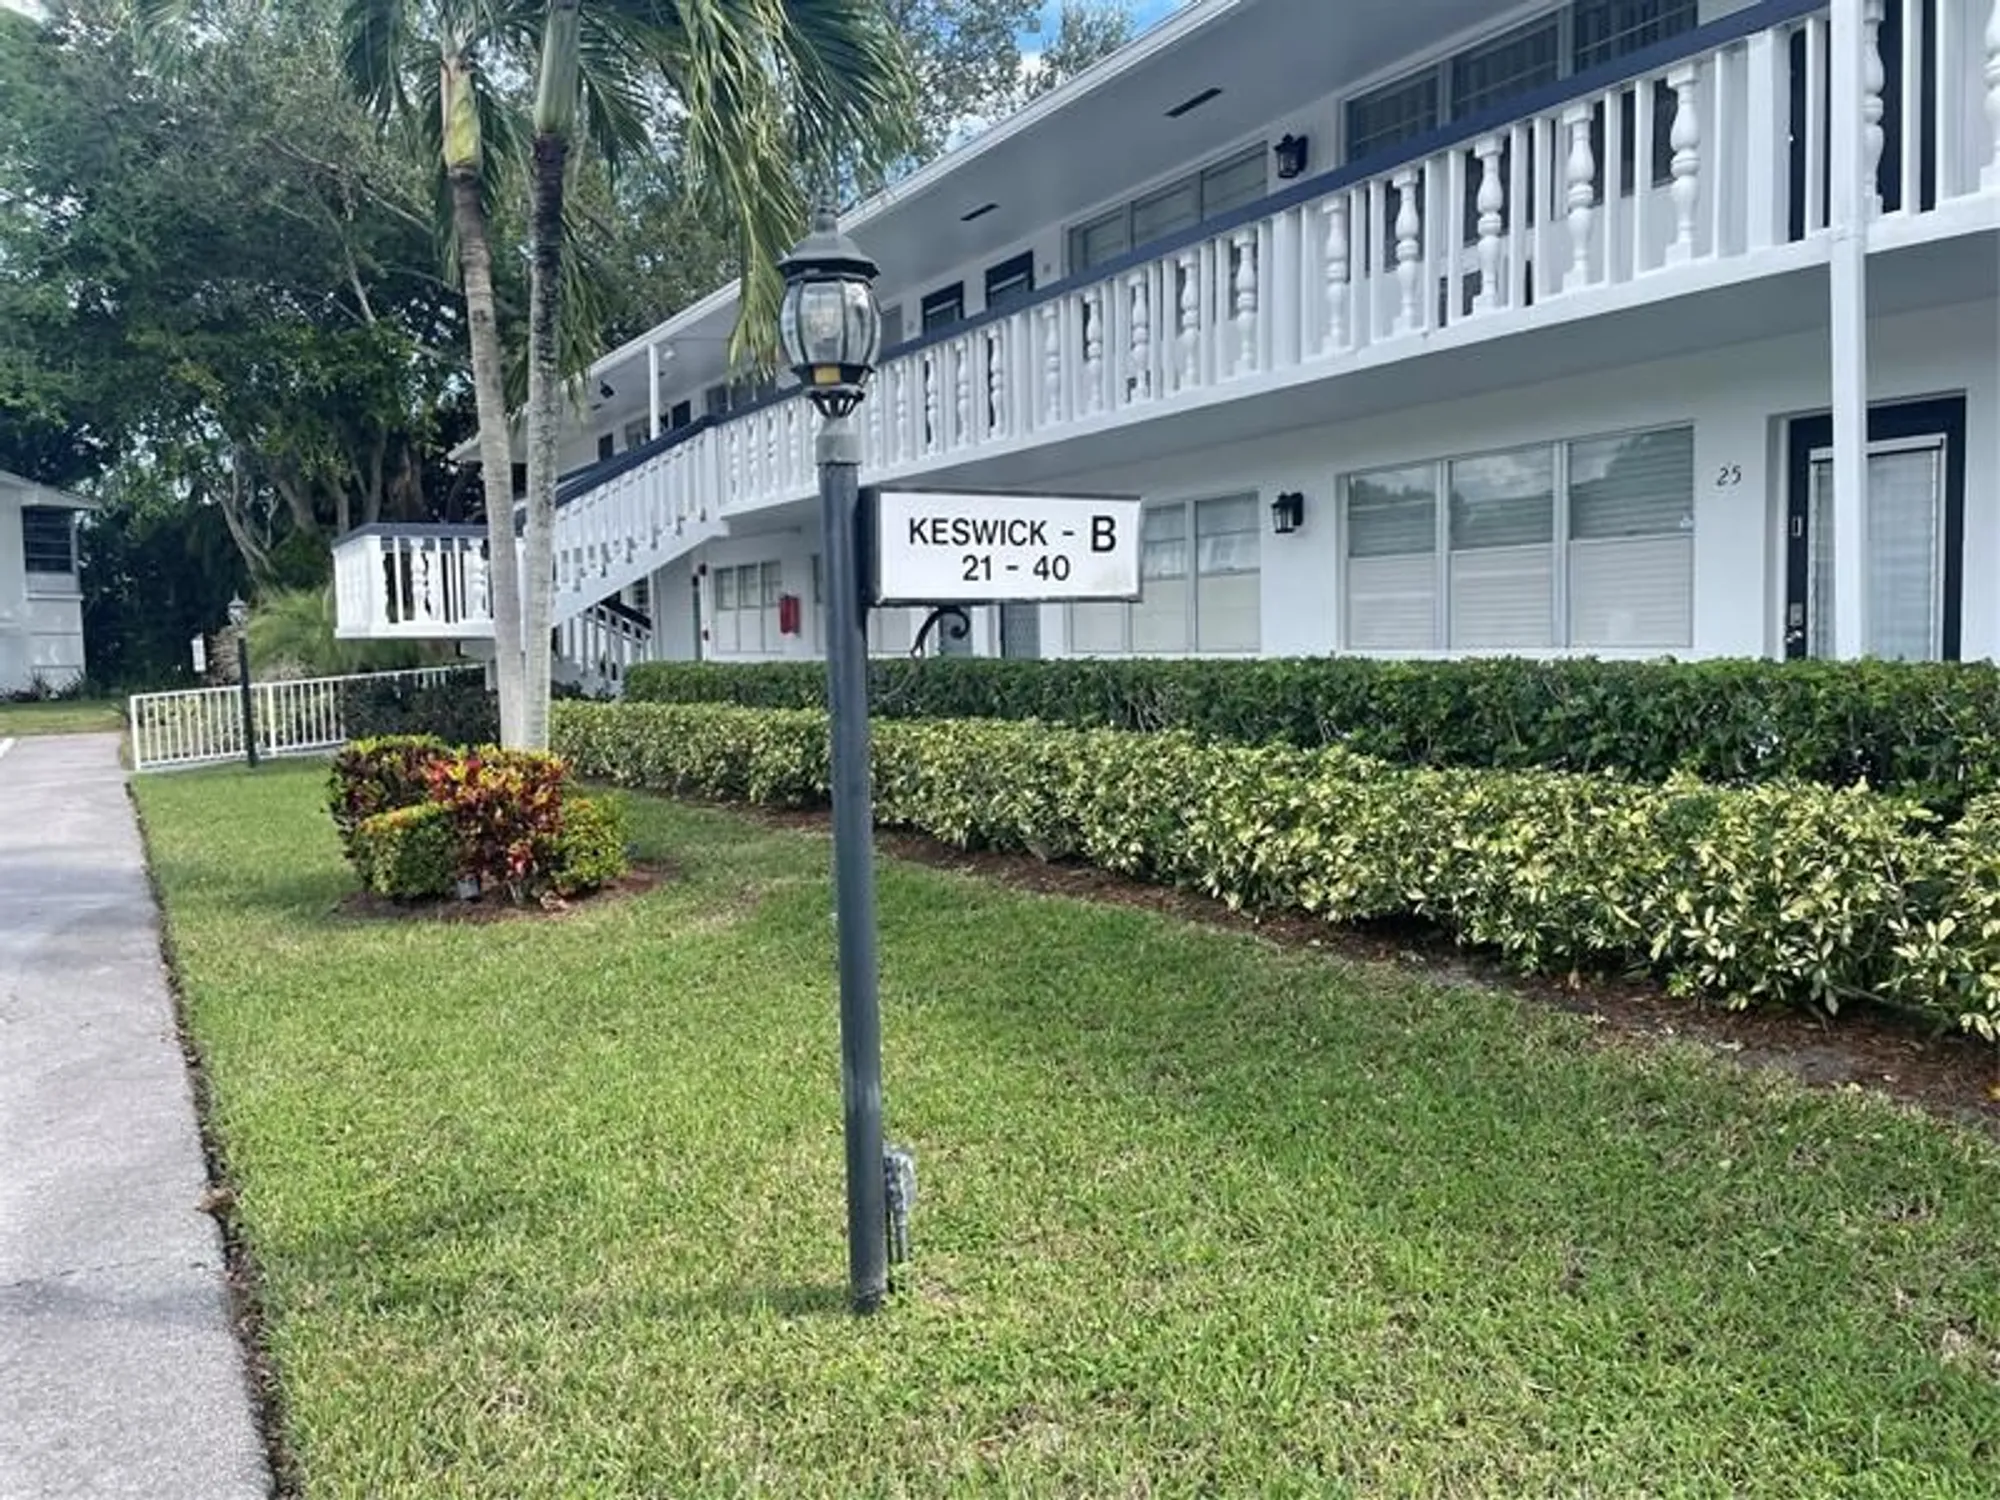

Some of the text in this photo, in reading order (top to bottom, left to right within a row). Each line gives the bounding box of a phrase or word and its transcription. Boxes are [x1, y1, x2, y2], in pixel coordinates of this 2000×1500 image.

[1716, 464, 1742, 487] 25
[908, 517, 1048, 547] KESWICK
[1091, 515, 1117, 553] B
[962, 554, 992, 581] 21
[1033, 554, 1071, 581] 40
